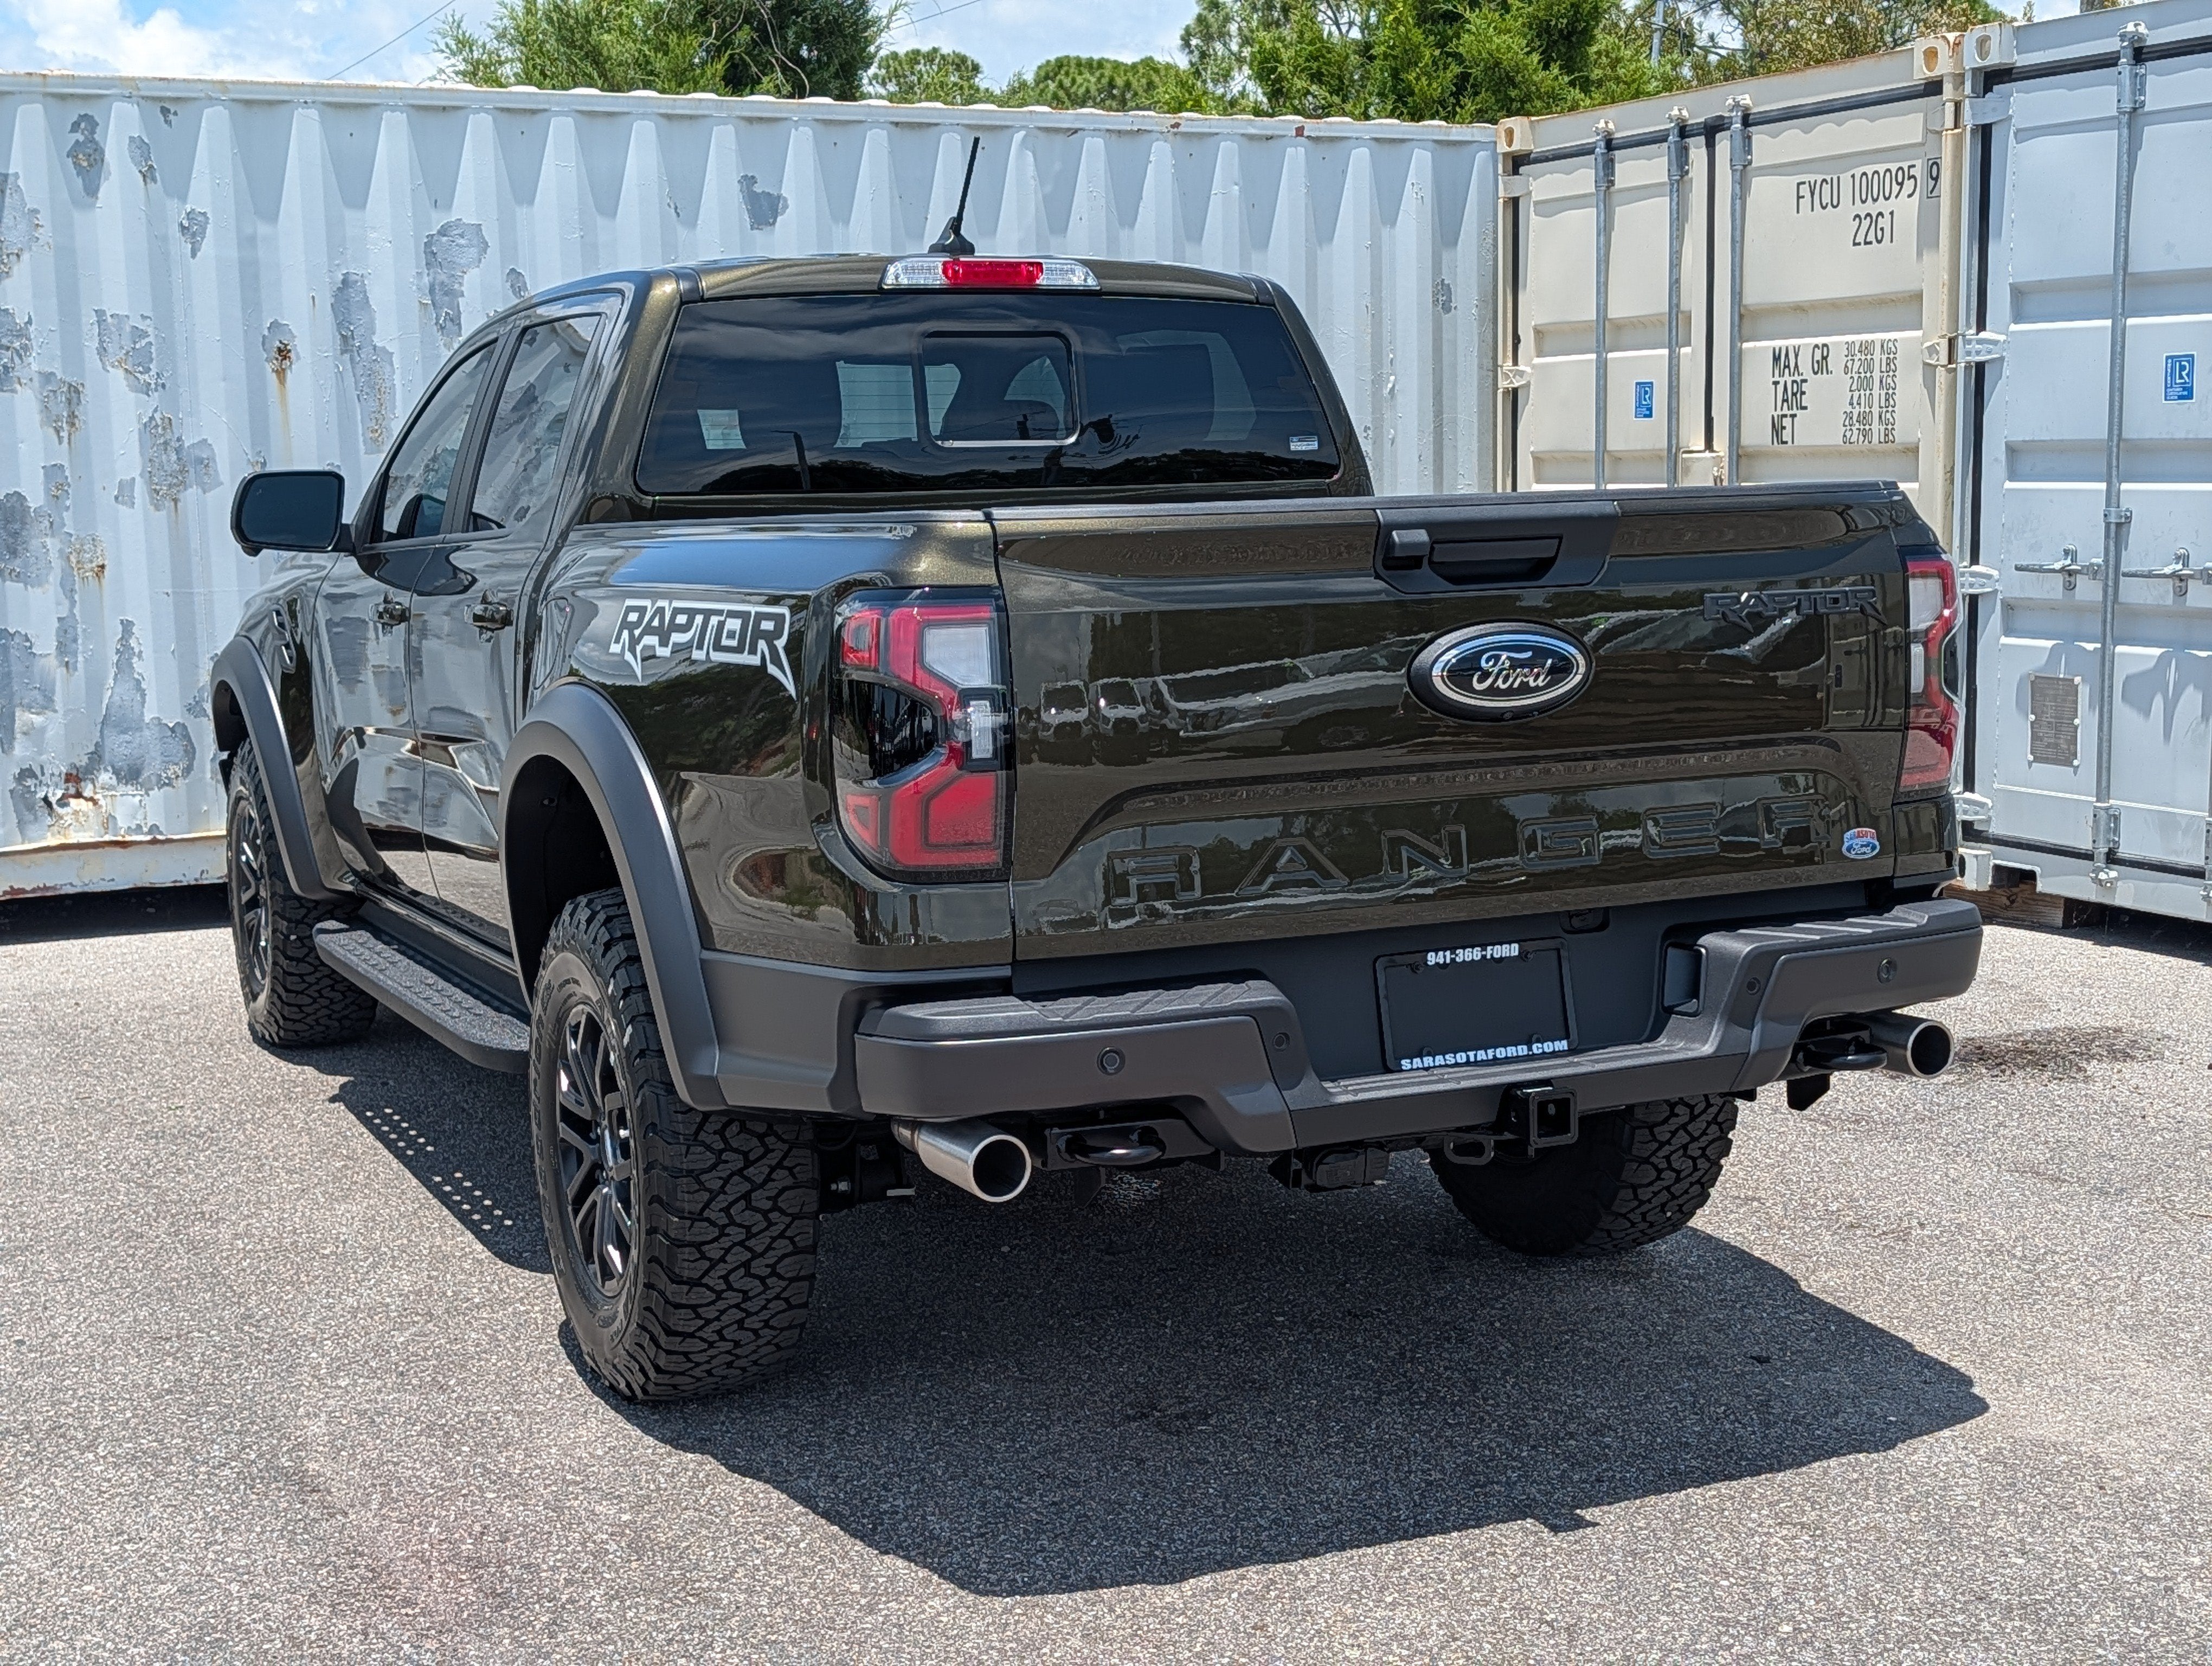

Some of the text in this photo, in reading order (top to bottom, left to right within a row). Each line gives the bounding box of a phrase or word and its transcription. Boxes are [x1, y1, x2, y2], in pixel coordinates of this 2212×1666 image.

[1796, 161, 1940, 214] FYCU 100095 9
[1852, 209, 1894, 247] 22G1
[1772, 343, 1833, 378] MAX. GR.
[1844, 338, 1898, 357] 30,480 KGS
[1879, 356, 1898, 373] LBS
[1771, 379, 1809, 412] TARE
[1879, 374, 1897, 391] KGS
[1878, 392, 1896, 408] LBS
[1771, 413, 1798, 445] NET
[1878, 409, 1896, 426] KGS
[1878, 427, 1896, 444] LBS
[1703, 585, 1887, 633] RAPTOR
[609, 598, 798, 701] RAPTOR
[1472, 651, 1553, 690] Ford
[1107, 793, 1833, 906] RANGER
[1850, 842, 1873, 854] Ford
[1426, 943, 1519, 965] 941-366-FORD
[1400, 1039, 1569, 1071] SARASOTAFORD.COM
